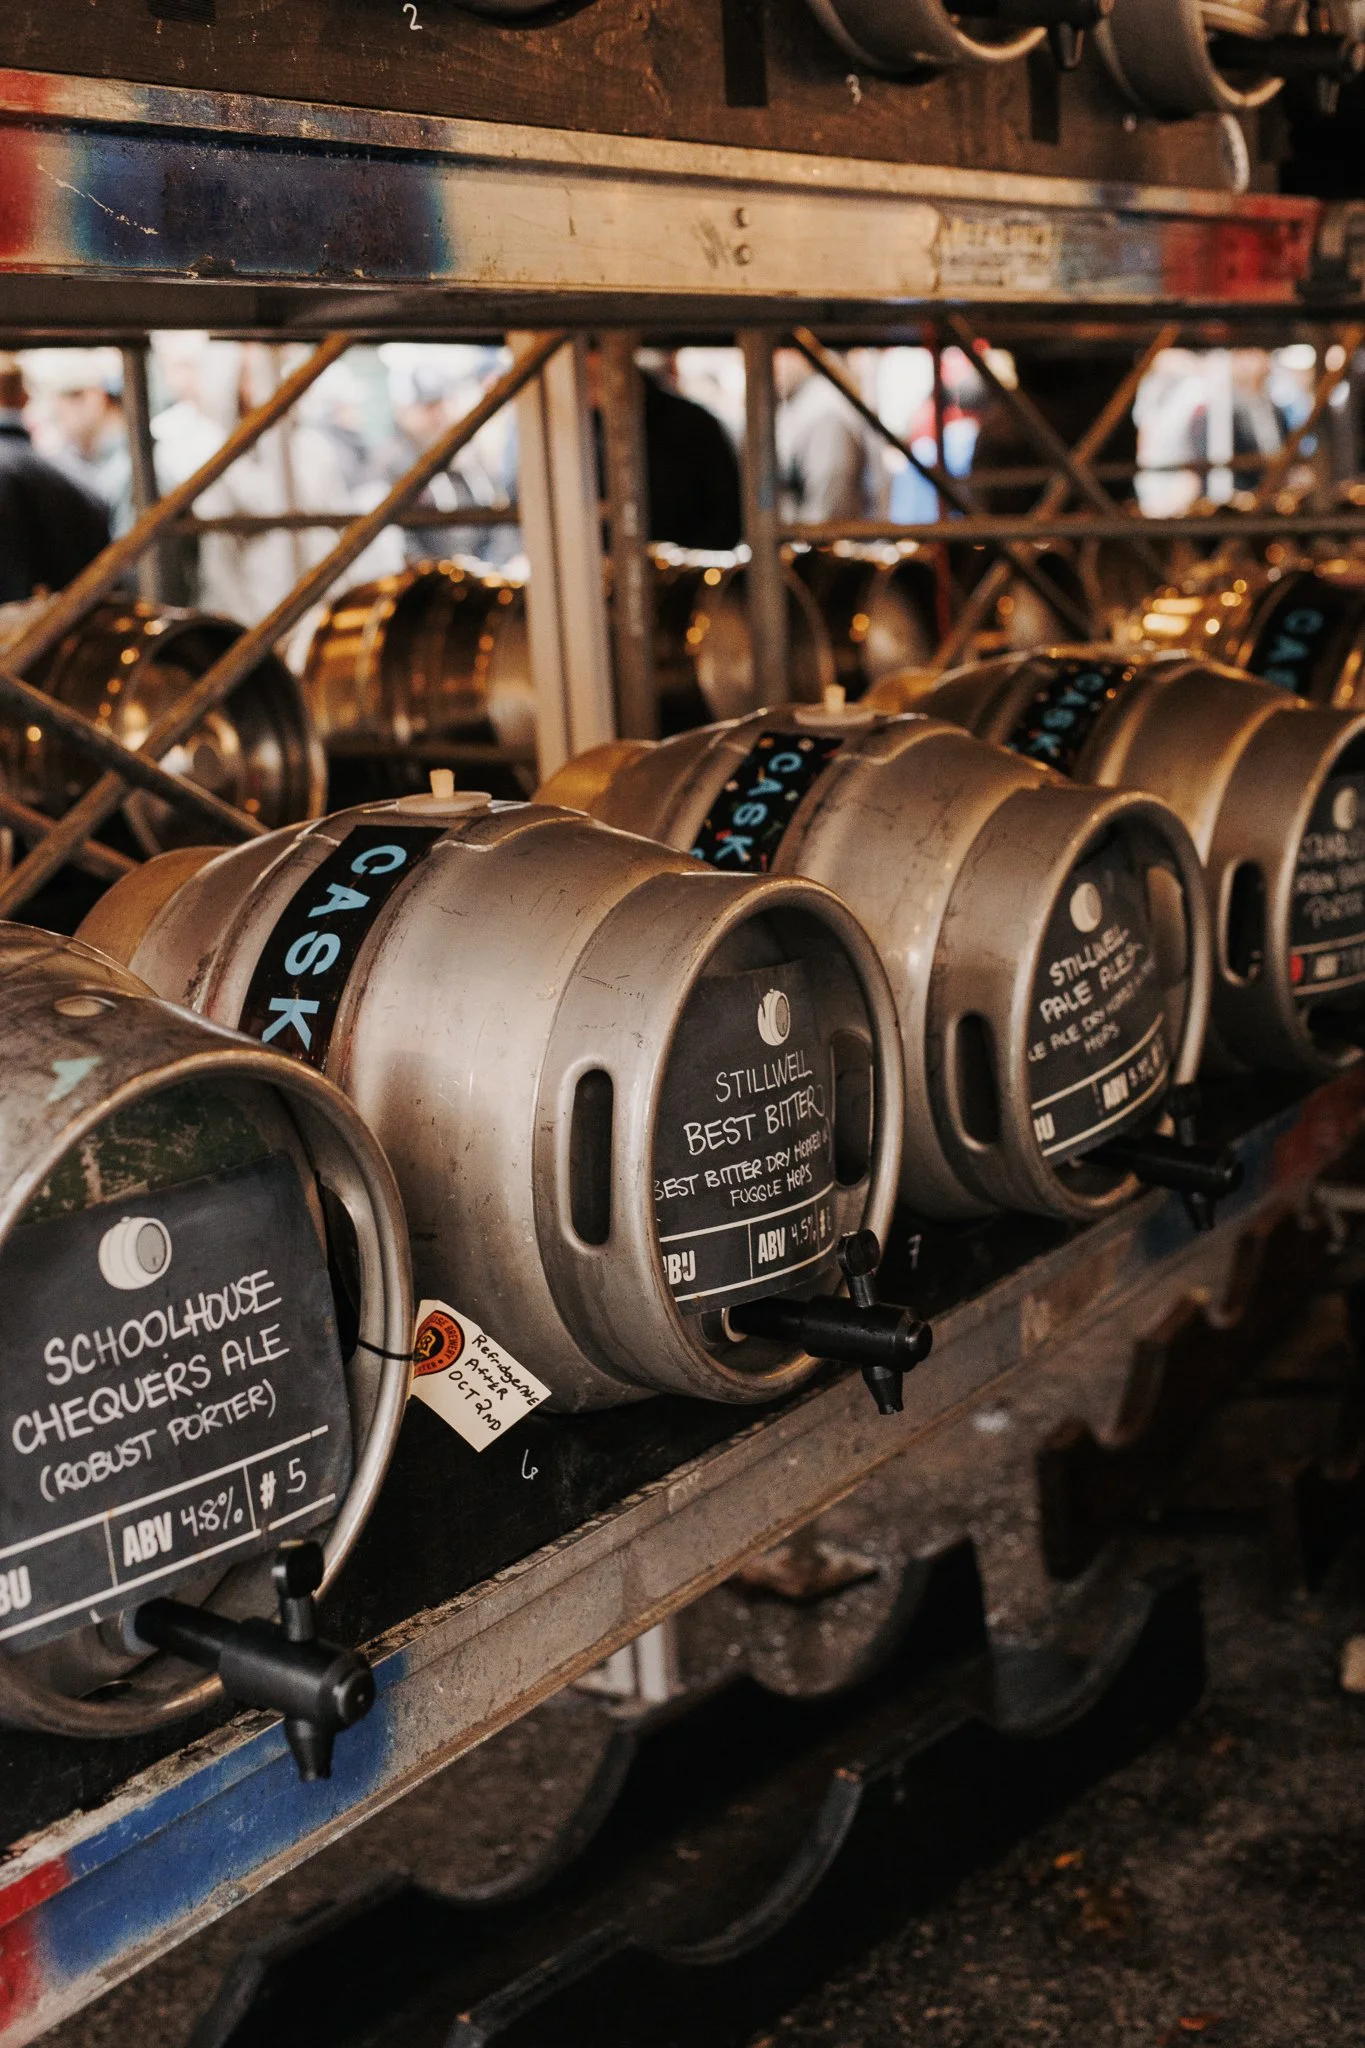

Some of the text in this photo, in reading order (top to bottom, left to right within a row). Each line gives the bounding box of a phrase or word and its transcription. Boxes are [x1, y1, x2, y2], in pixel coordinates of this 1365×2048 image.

[403, 3, 423, 30] 2
[715, 751, 803, 863] CASK
[262, 844, 407, 1051] CASK
[1040, 979, 1093, 1024] PALE
[716, 1050, 814, 1102] STILLWELL
[683, 1085, 824, 1156] BEST BITTER
[654, 1174, 699, 1201] BEST
[704, 1159, 762, 1188] BITTER
[766, 1147, 790, 1172] DRY
[730, 1163, 812, 1207] FUGGLE HOPS
[758, 1227, 786, 1264] ABV
[44, 1269, 281, 1385] SCHOOLHOUSE
[12, 1323, 290, 1454] CHEQUERS ALE
[449, 1371, 502, 1431] OCT 2ND
[40, 1379, 276, 1502] (ROBUST PORTER)
[522, 1449, 539, 1480] 6
[122, 1511, 173, 1567] ABV
[180, 1486, 243, 1537] 4.8%
[287, 1458, 307, 1493] 5
